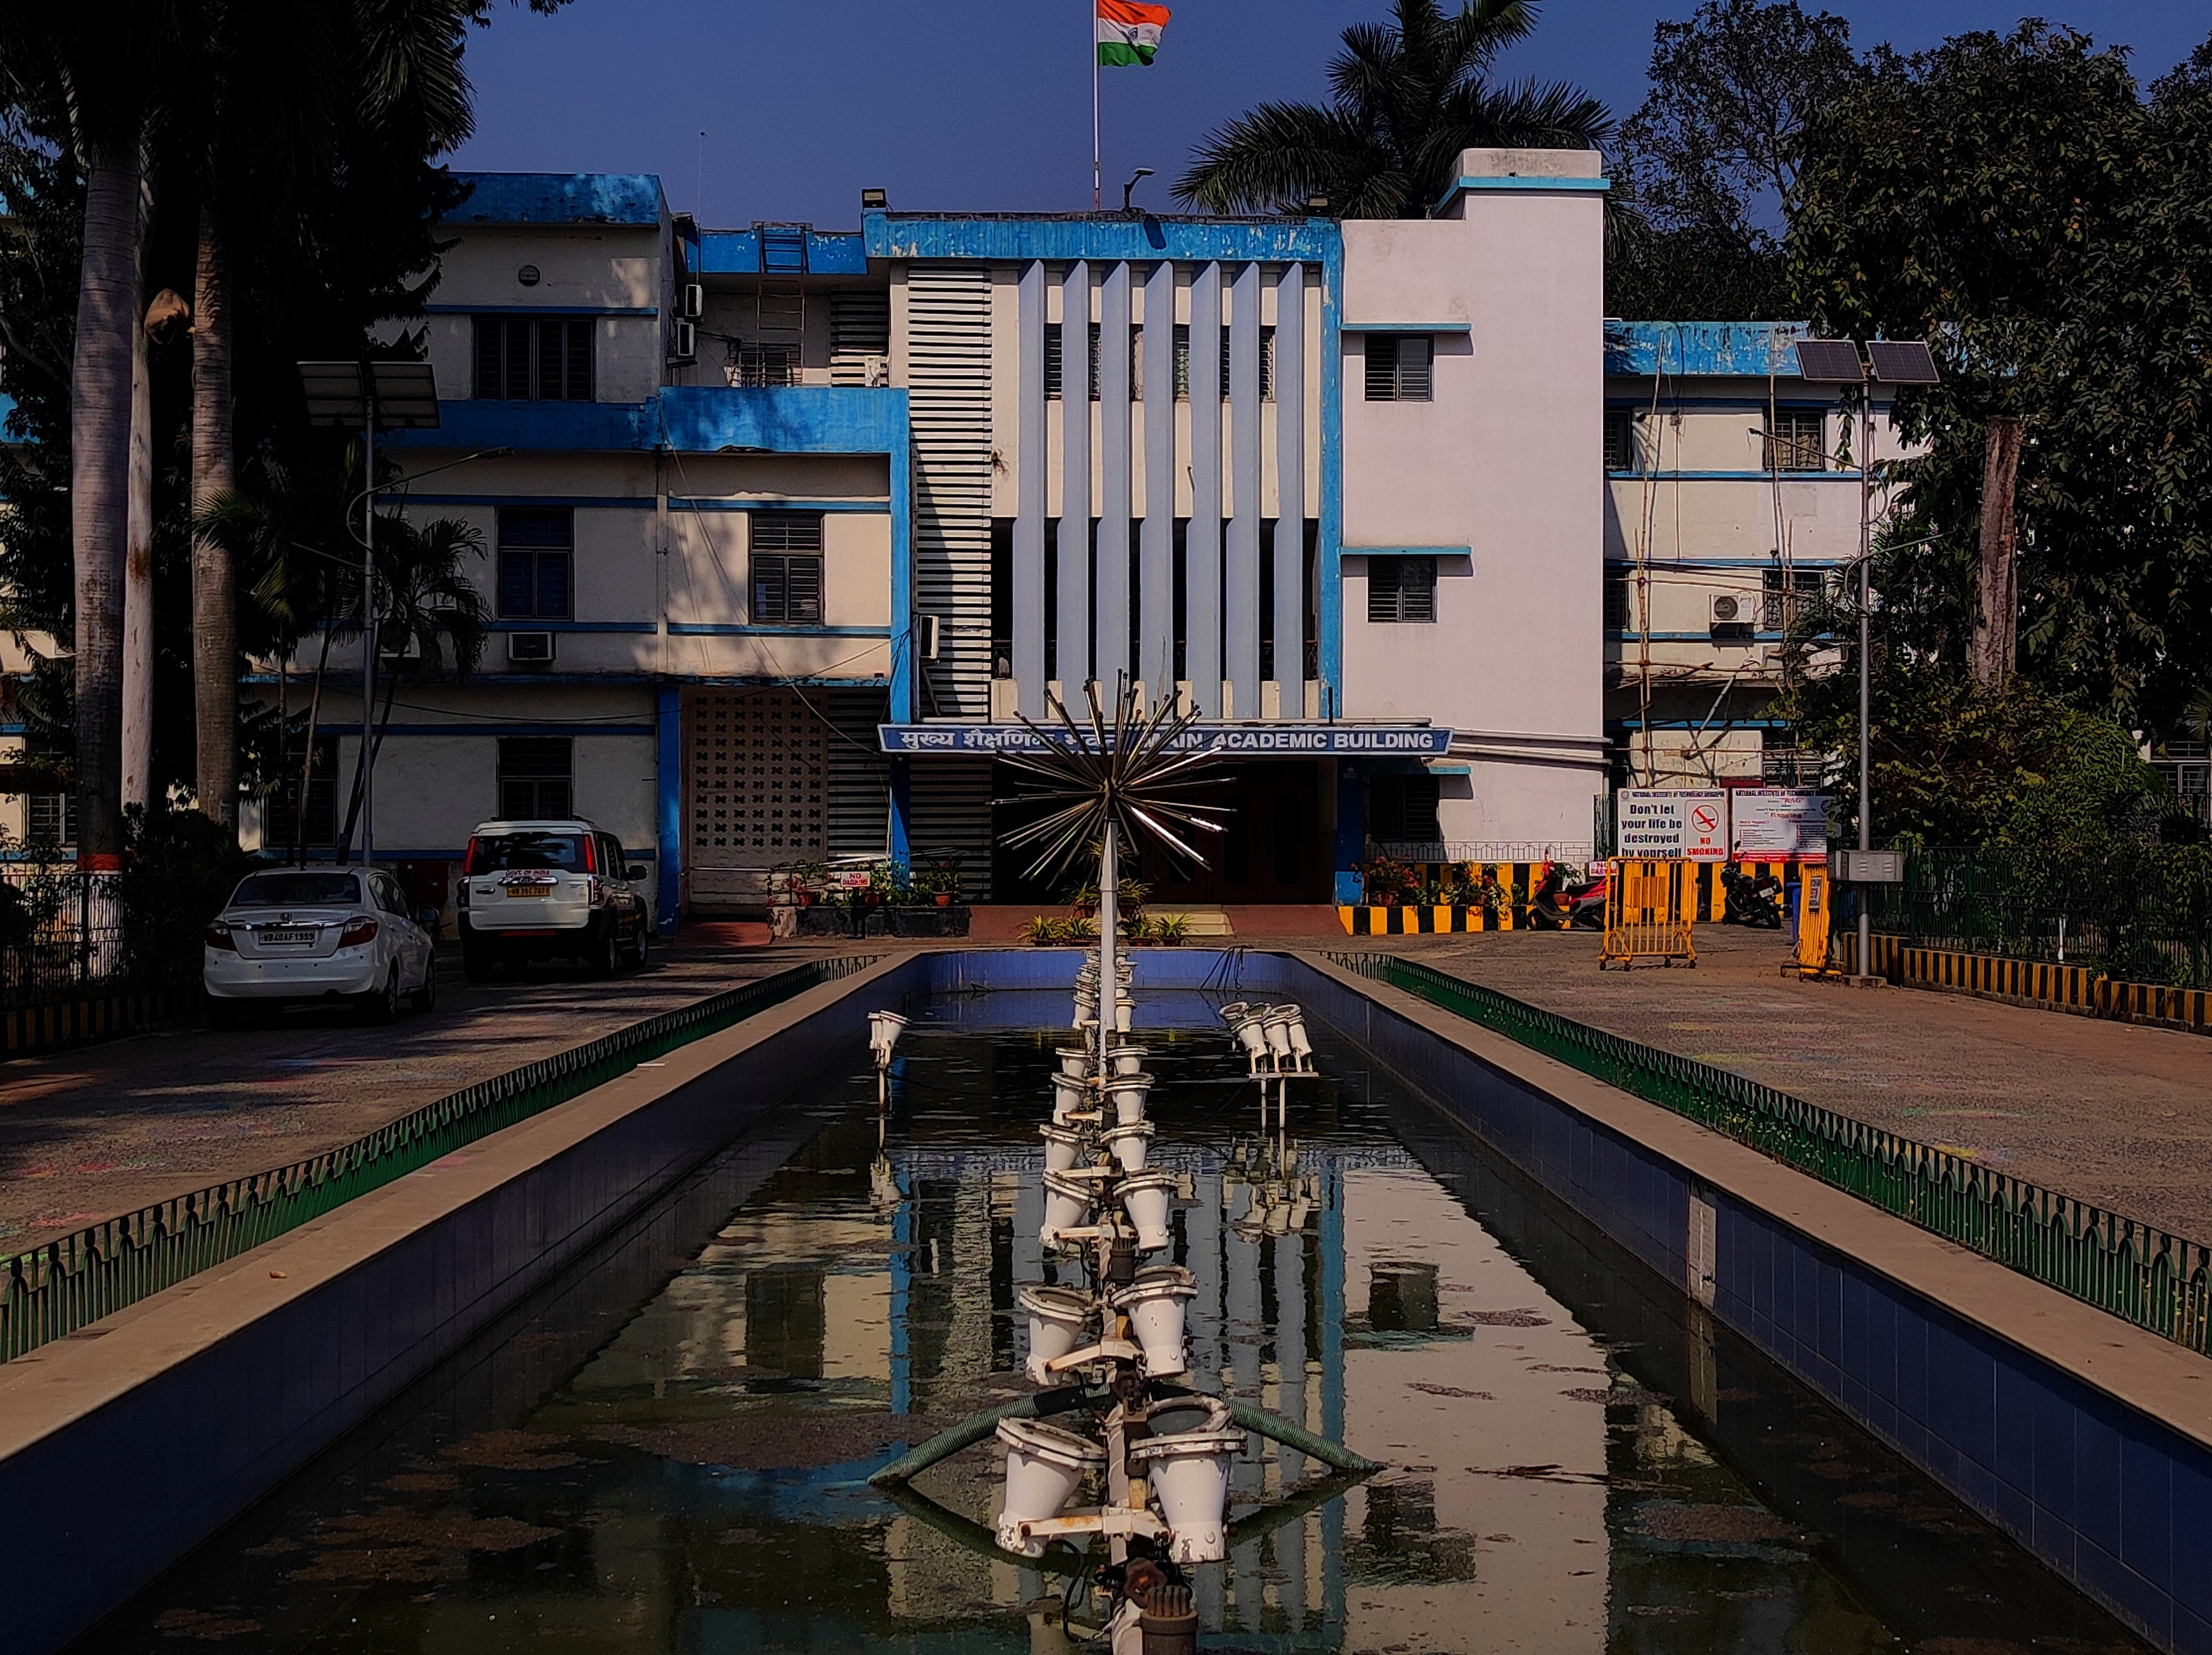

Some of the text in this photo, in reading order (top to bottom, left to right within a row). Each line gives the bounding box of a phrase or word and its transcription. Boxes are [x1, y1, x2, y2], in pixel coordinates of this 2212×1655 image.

[900, 732, 955, 749] मुख्य
[1210, 733, 1327, 748] ACADEMIC
[1333, 733, 1433, 748] BUILDING
[1630, 804, 1674, 814] Don't let
[1621, 818, 1682, 829] your life be
[1624, 834, 1679, 844] destroyed
[1700, 837, 1711, 845] NO
[1687, 847, 1724, 856] SMOKING
